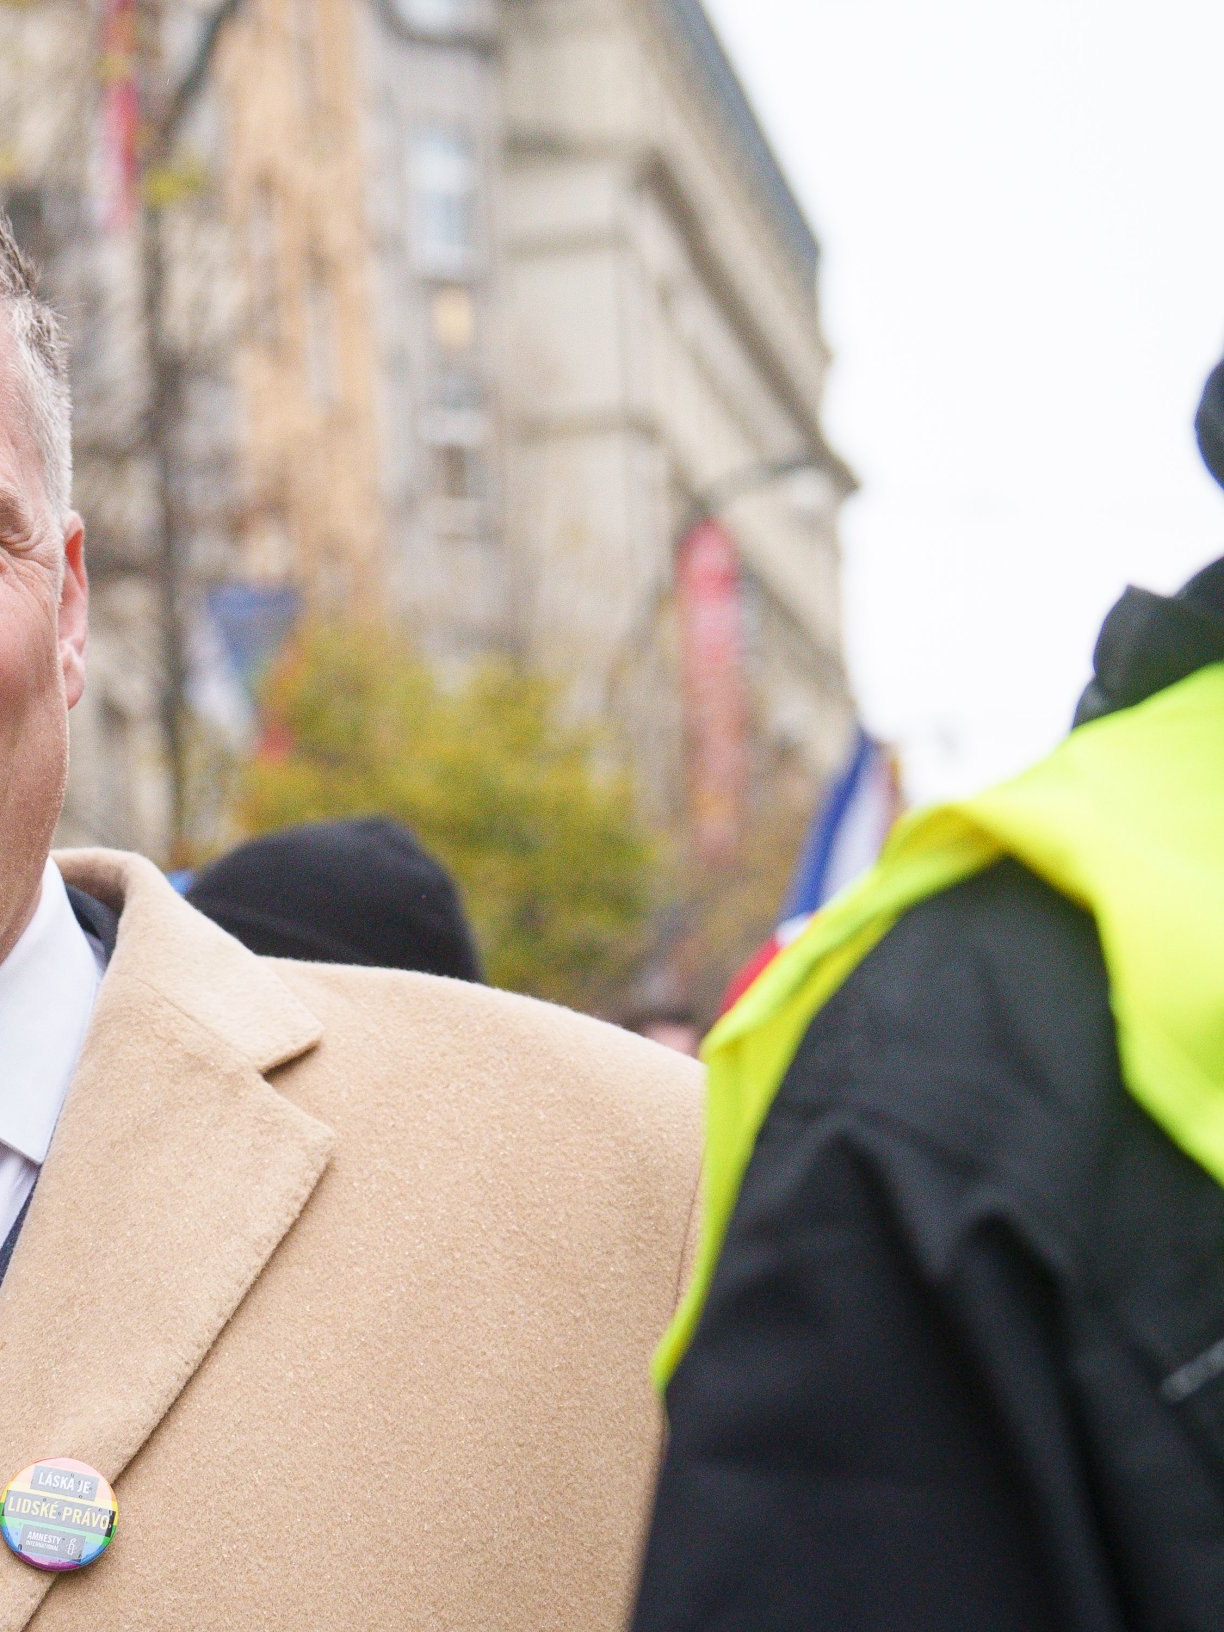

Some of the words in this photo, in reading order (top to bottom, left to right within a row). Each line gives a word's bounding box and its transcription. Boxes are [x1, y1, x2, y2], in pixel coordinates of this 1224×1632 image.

[38, 1472, 74, 1490] LÁSKA
[77, 1481, 92, 1494] JE
[8, 1497, 58, 1519] LIDSKÉ
[62, 1508, 110, 1530] PRÁVO
[27, 1531, 62, 1545] AMNESTY
